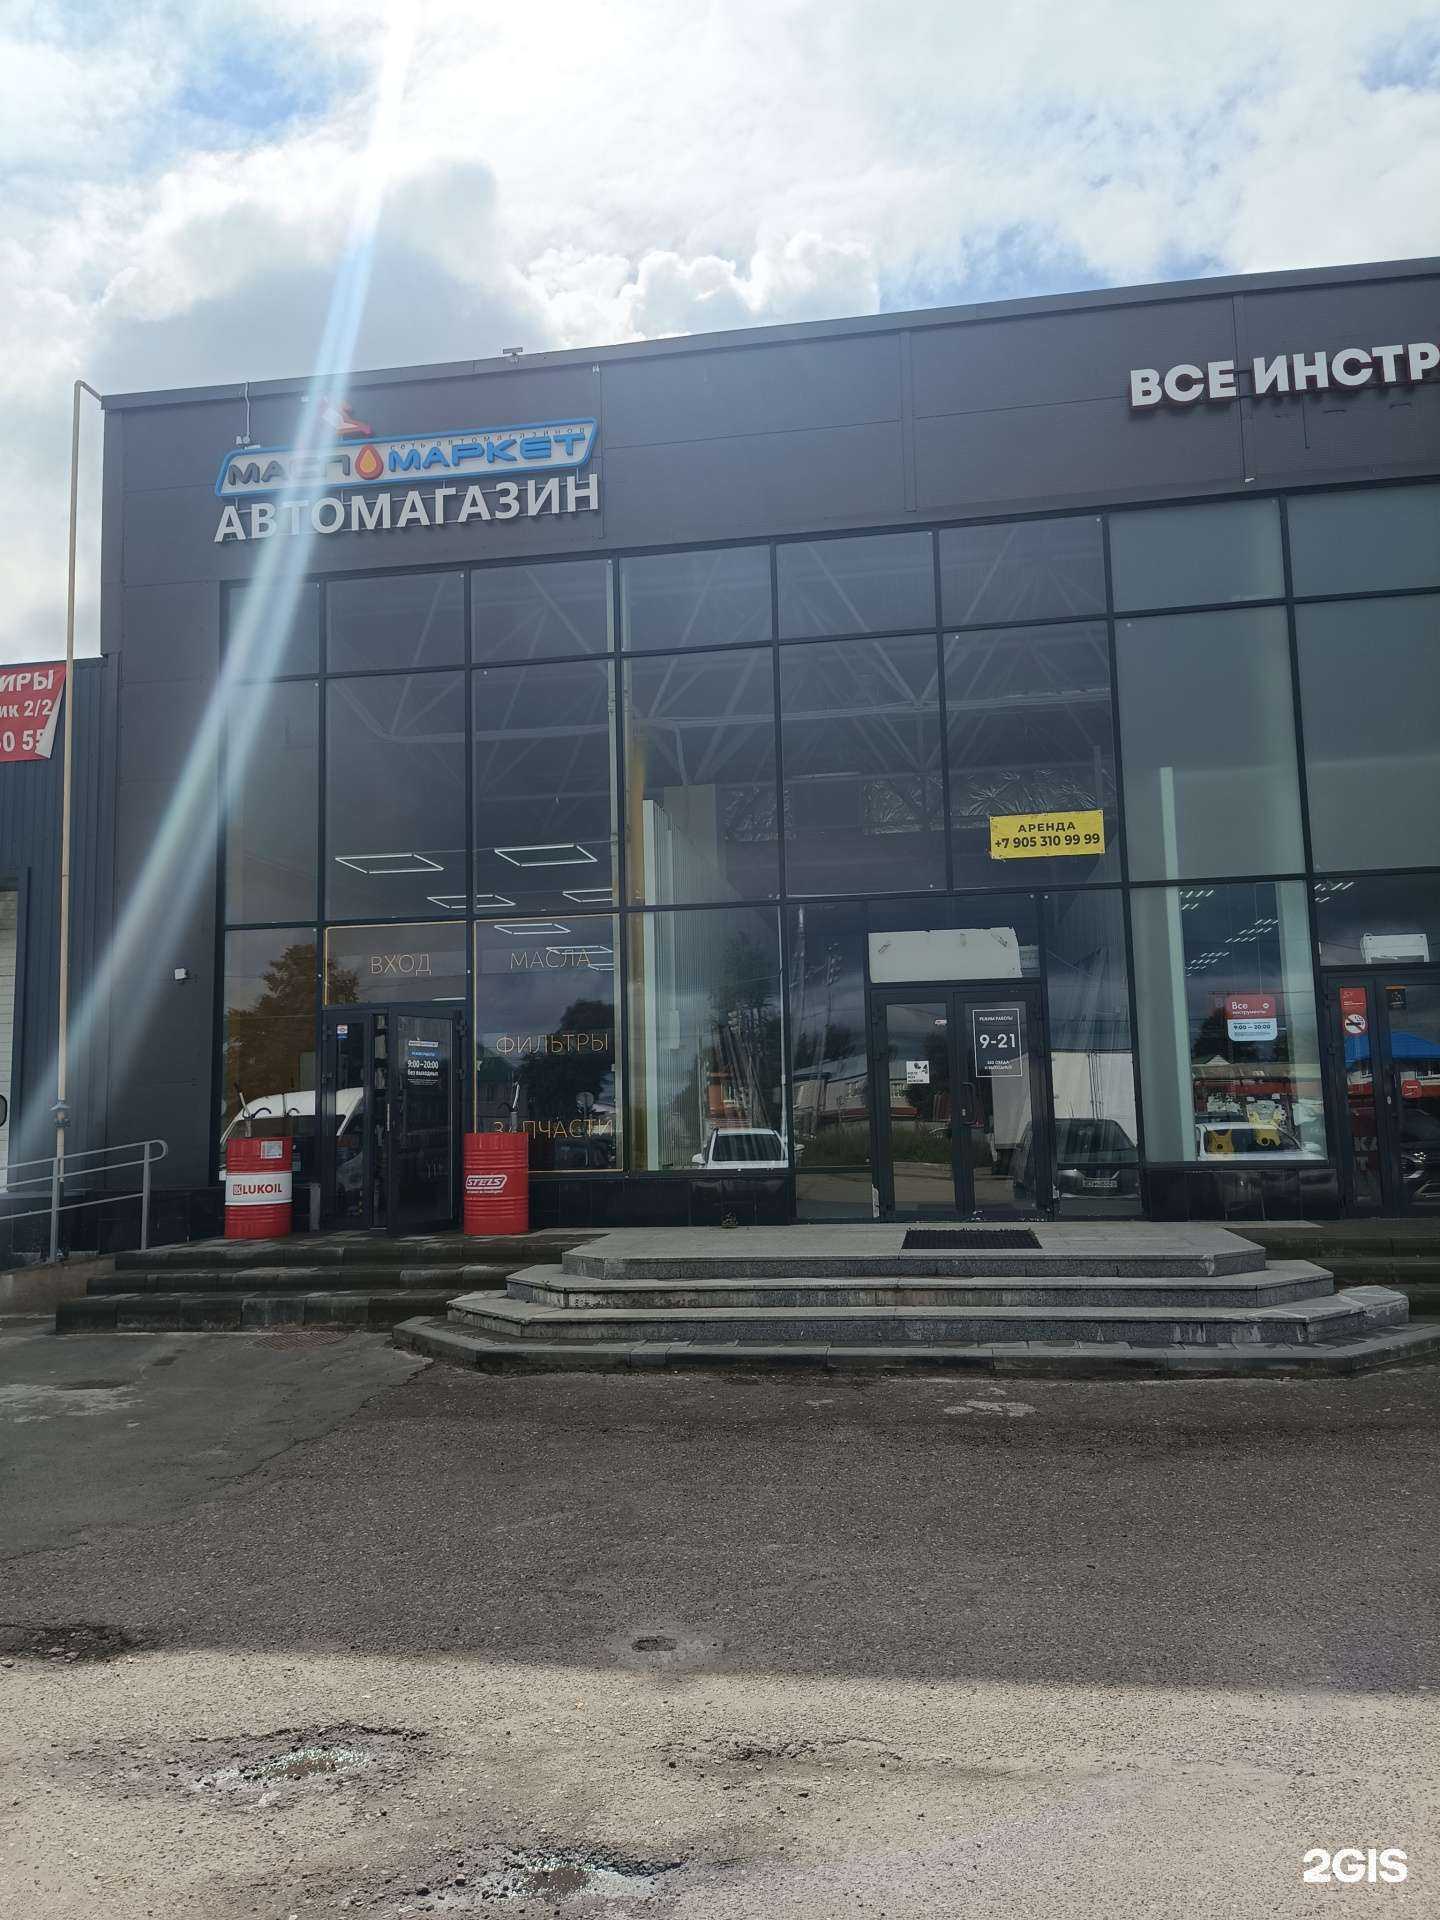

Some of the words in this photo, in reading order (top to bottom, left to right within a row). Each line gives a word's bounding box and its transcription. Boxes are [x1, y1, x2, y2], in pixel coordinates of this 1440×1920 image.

[1130, 359, 1237, 407] ВСЕ
[1253, 342, 1440, 395] ИНСТР
[214, 474, 599, 543] АВТОМАГАЗИН
[1018, 821, 1076, 833] АРЕНДА
[995, 838, 1009, 849] +7
[1013, 836, 1037, 848] 905
[1040, 835, 1061, 846] 310
[1064, 834, 1080, 845] 99
[1084, 833, 1100, 844] 99
[371, 952, 432, 977] ВХОД
[510, 949, 591, 969] МАСЛА
[496, 1033, 608, 1054] ФИЛЬТРЫ
[979, 1033, 1016, 1049] 9-21
[494, 1119, 613, 1140] ЗПЧАСТИ
[242, 1183, 283, 1195] LUKOIL
